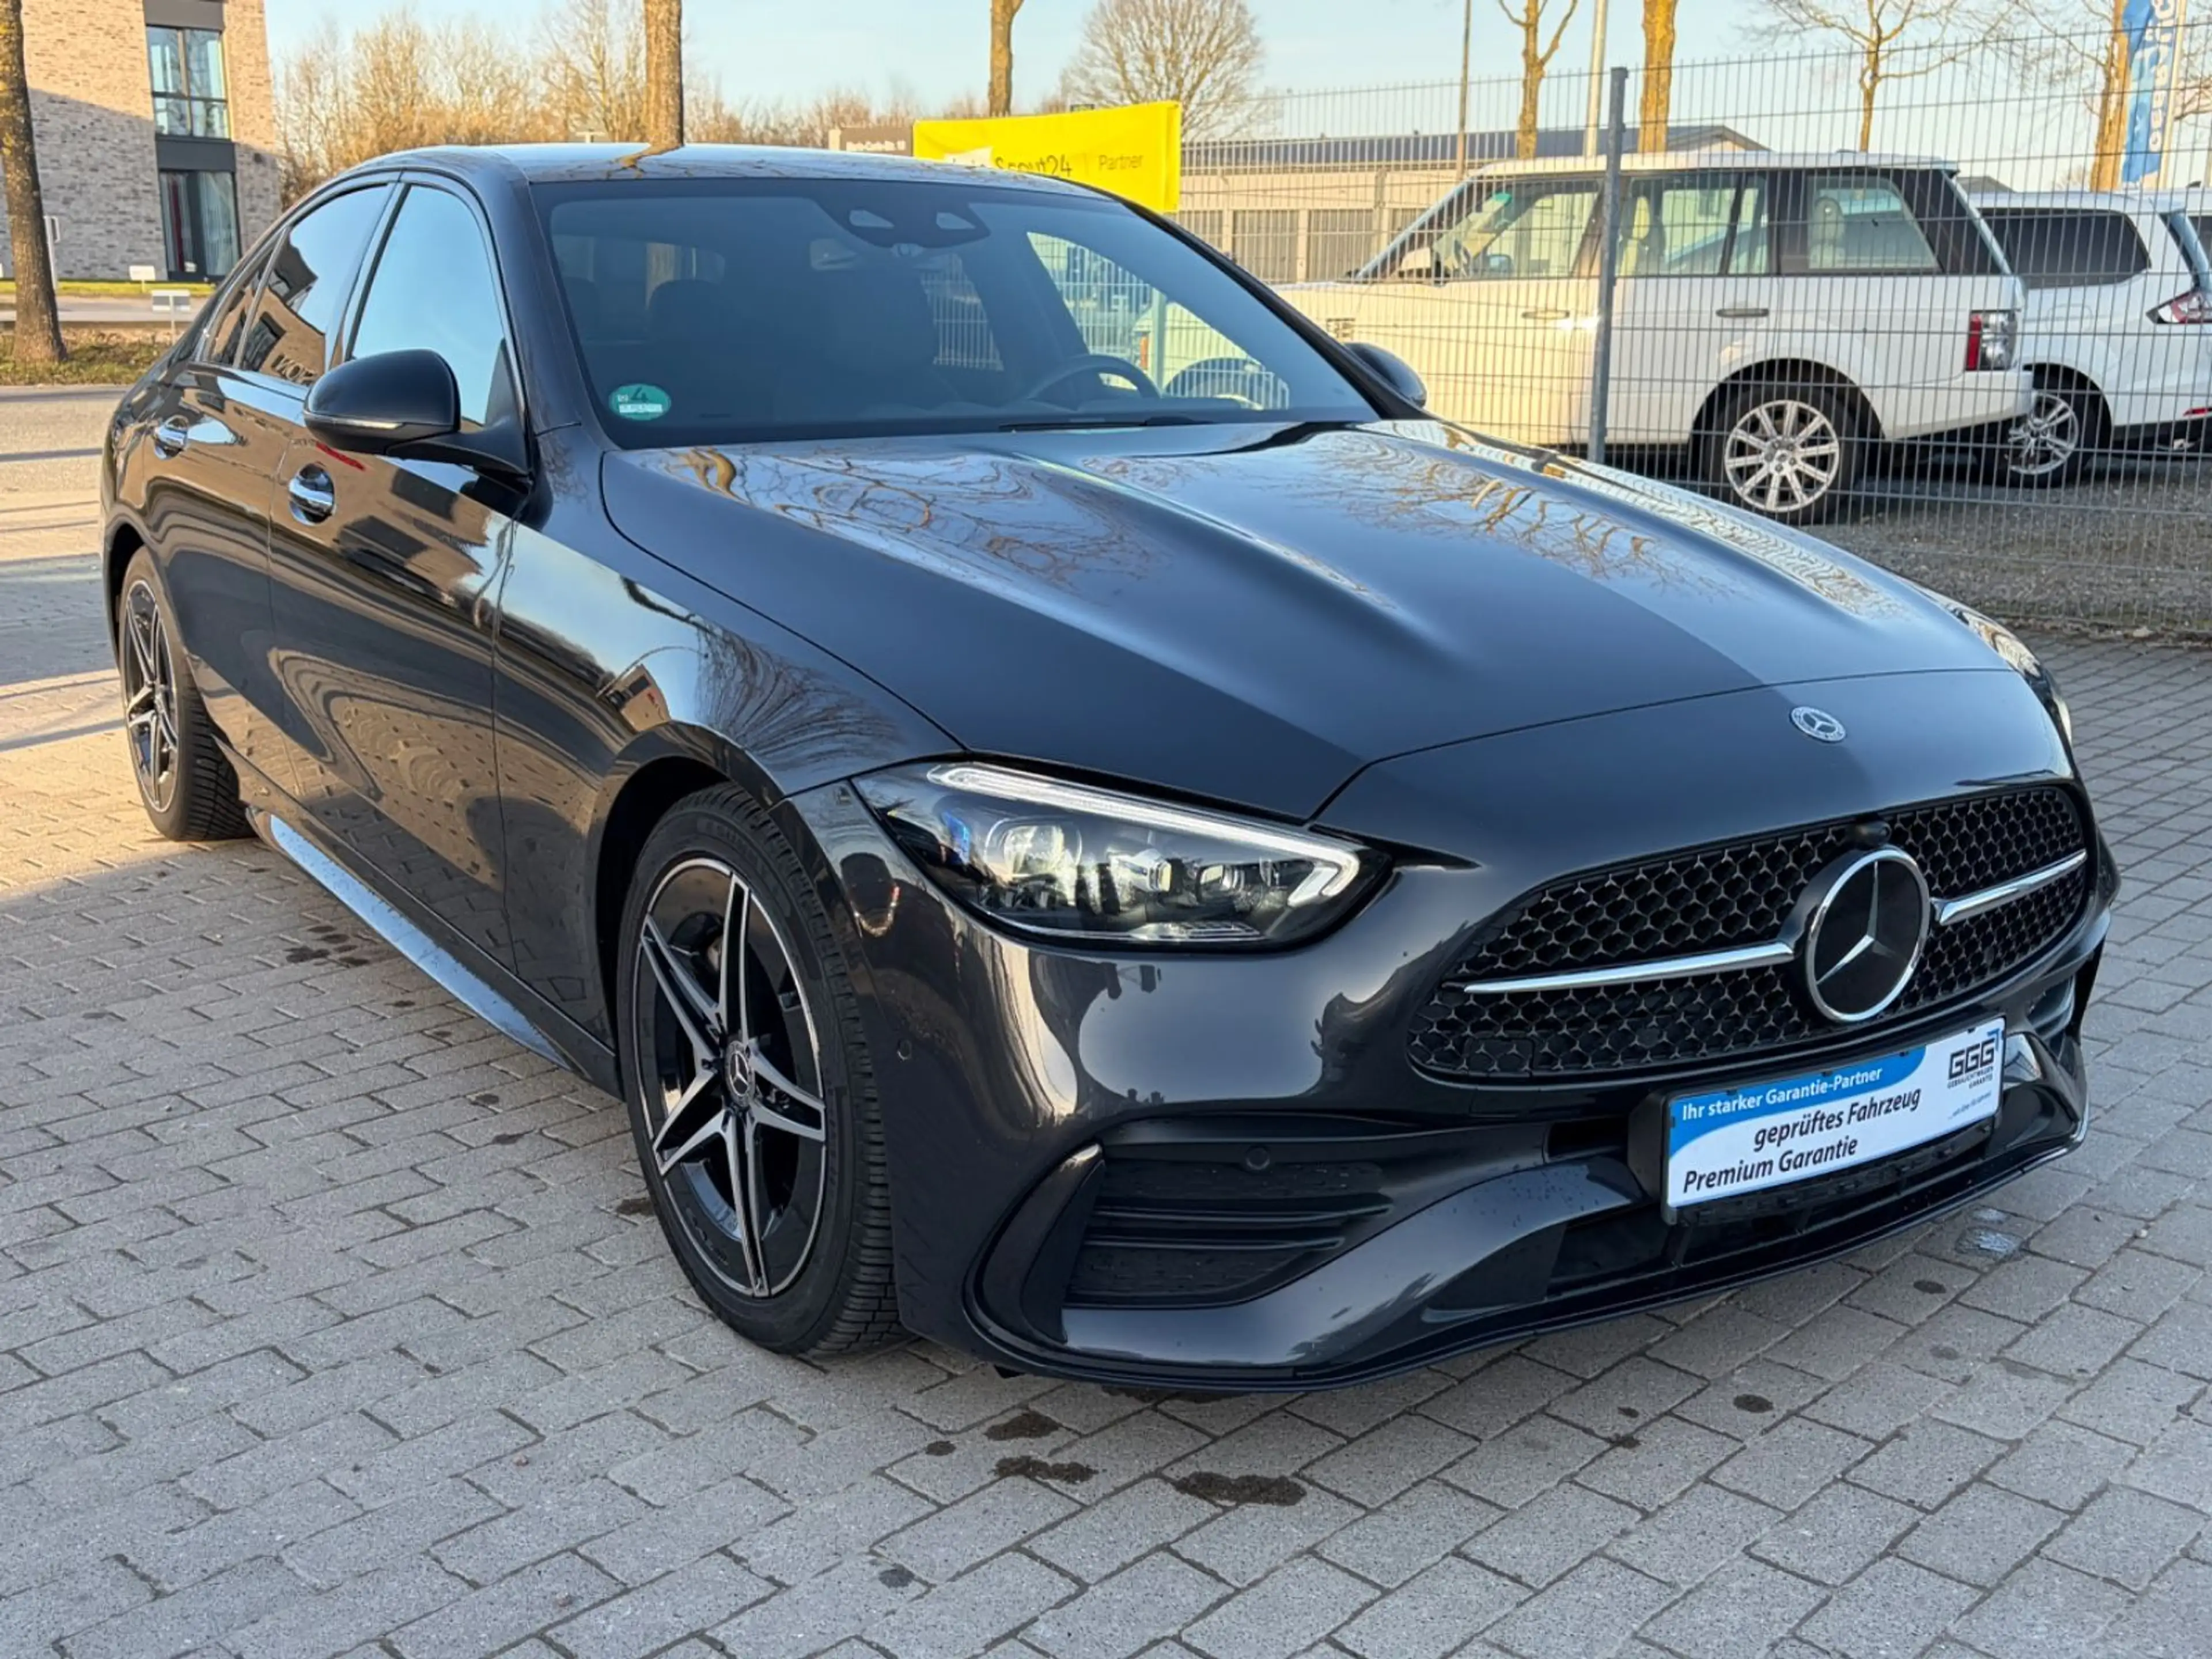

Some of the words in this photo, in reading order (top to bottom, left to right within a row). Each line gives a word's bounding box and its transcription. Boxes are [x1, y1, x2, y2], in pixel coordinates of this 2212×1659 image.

[1098, 154, 1143, 171] Partner
[631, 385, 649, 403] 4
[1948, 1037, 1995, 1080] GGG
[1683, 1103, 1705, 1120] Ihr
[1708, 1094, 1763, 1116] starker
[1766, 1067, 1883, 1104] Garantie-Partner
[1753, 1109, 1844, 1152] geprüftes
[1847, 1088, 1922, 1124] Fahrzeug
[1683, 1158, 1774, 1194] Premium
[1779, 1135, 1858, 1173] Garantie
